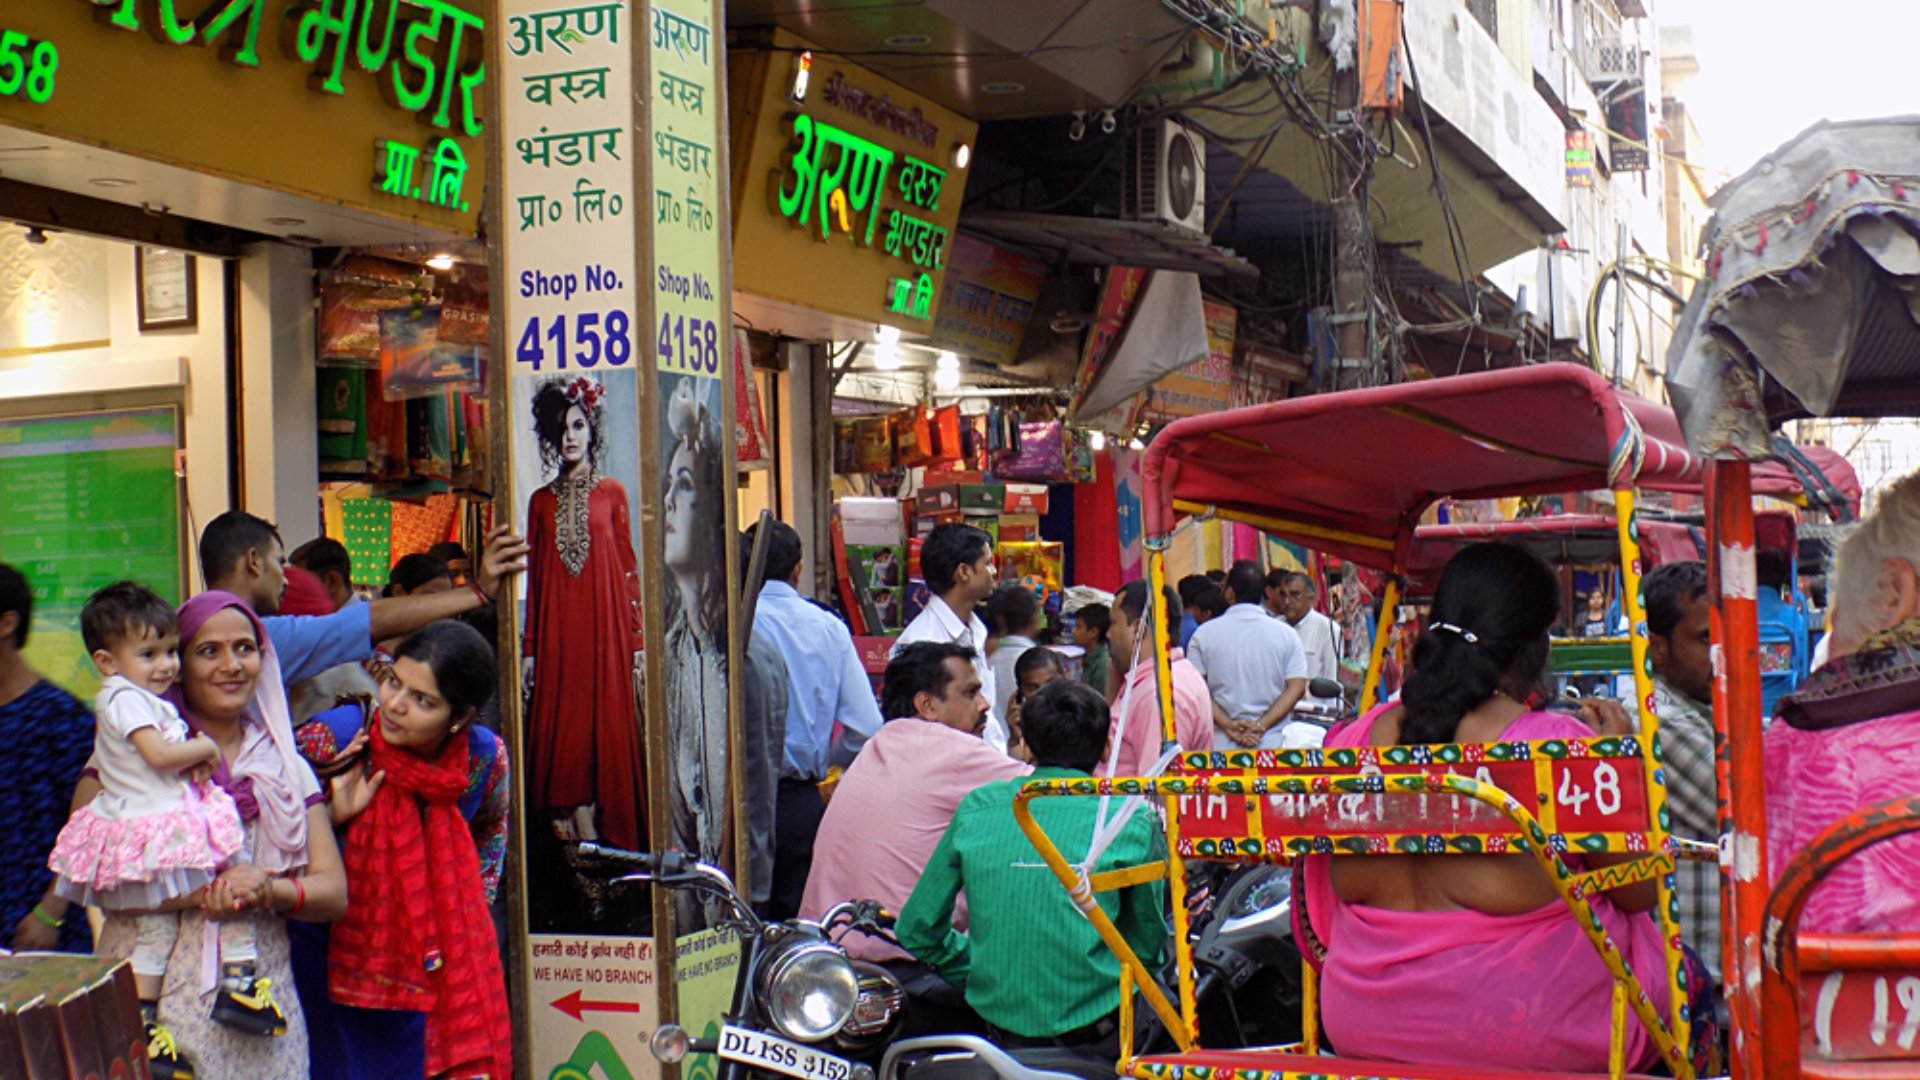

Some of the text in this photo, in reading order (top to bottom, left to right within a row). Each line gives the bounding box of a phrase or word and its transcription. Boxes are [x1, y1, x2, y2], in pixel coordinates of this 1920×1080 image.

[523, 66, 611, 106] वस्त्र
[658, 70, 705, 116] वस्त्र
[516, 126, 623, 168] भंडार
[655, 124, 711, 178] भंडार
[898, 154, 948, 212] वस्त्र
[520, 264, 623, 299] Shop No.
[658, 264, 714, 302] Shop No.
[443, 308, 489, 325] GRASIM
[516, 309, 631, 371] 4158
[658, 311, 718, 375] 4158
[1558, 759, 1621, 816] 48
[532, 939, 562, 957] हमारी
[565, 940, 588, 959] कोई
[533, 967, 653, 985] WE HAVE NO BRANCH
